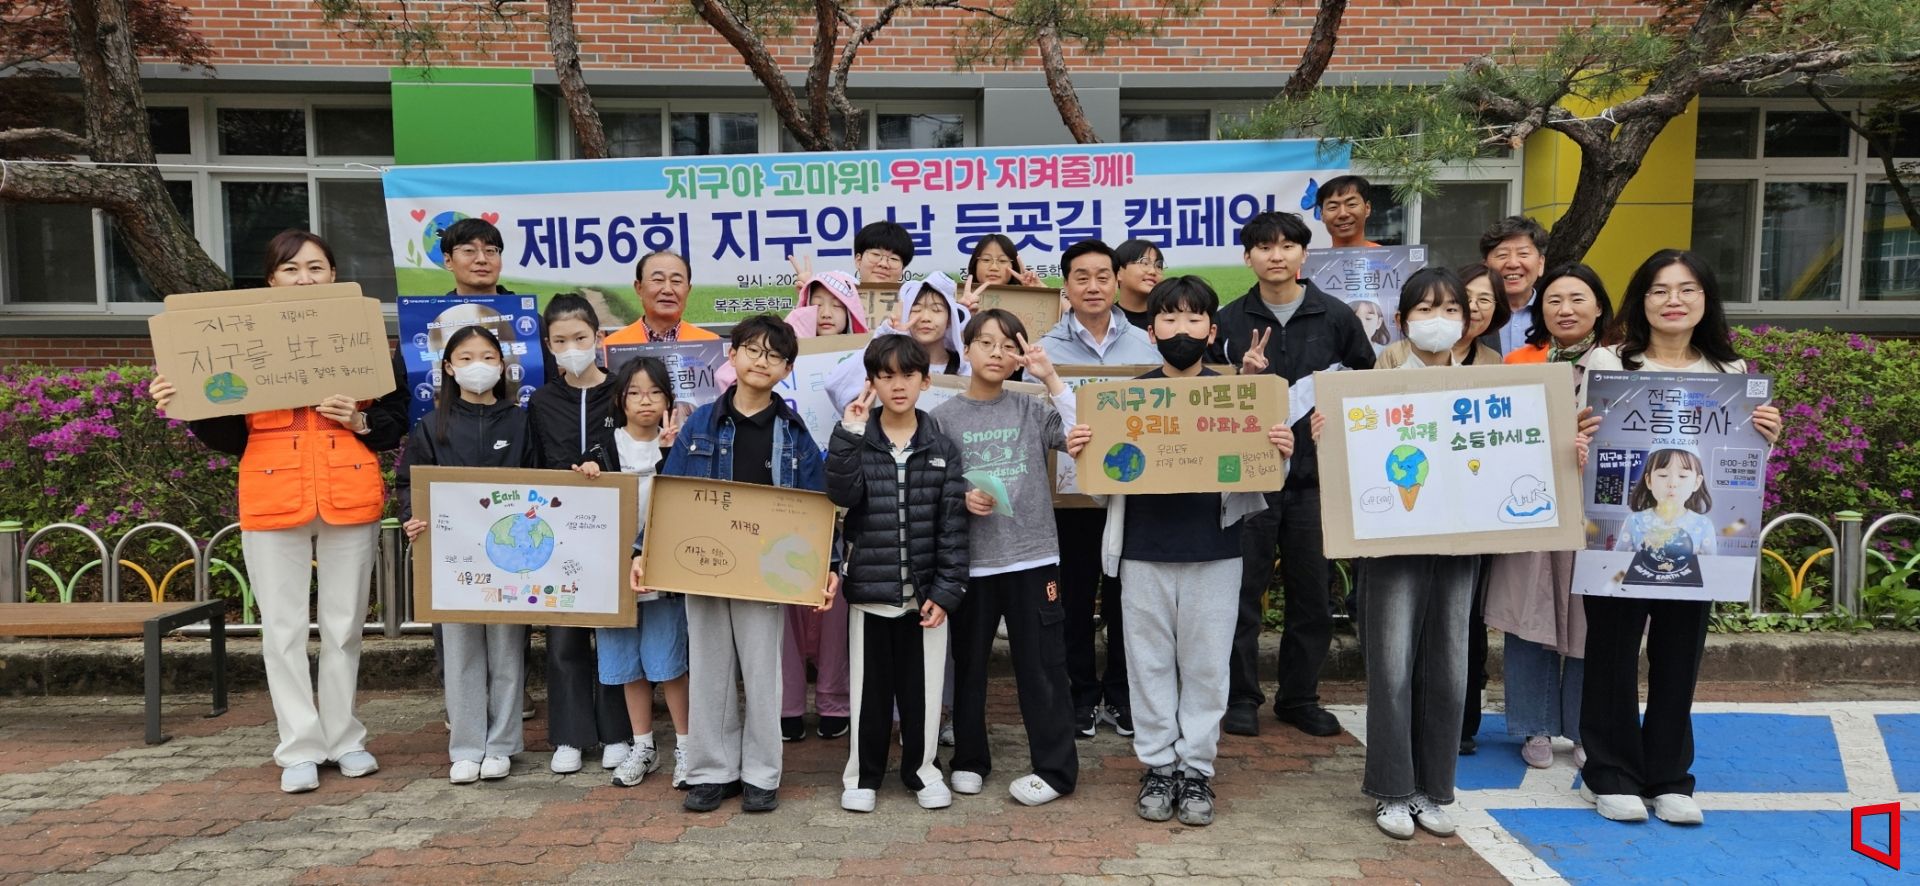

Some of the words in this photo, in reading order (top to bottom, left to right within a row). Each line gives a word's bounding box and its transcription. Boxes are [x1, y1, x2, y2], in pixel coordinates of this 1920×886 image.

[664, 164, 764, 199] 지구야
[774, 161, 879, 195] 고마워!
[890, 158, 987, 193] 우리가
[996, 154, 1133, 189] 지켜줄께!
[517, 212, 691, 268] 제56회
[711, 206, 862, 261] 지구의
[955, 200, 1102, 256] 등굣길
[737, 274, 762, 288] 일시
[1325, 272, 1400, 291] 소등행사
[194, 315, 256, 332] 지구를
[179, 339, 272, 374] 지구를
[287, 335, 322, 361] 보호
[256, 369, 310, 385] 에너지를
[313, 367, 336, 378] 절약
[1097, 386, 1176, 412] 지구가
[1189, 382, 1257, 410] 아프면
[1648, 388, 1682, 406] 전국
[1125, 415, 1180, 441] 우리도
[1196, 415, 1262, 433] 아파요
[1348, 404, 1379, 432] 오늘
[1385, 403, 1414, 427] 10분
[1621, 409, 1732, 435] 소등행사
[962, 427, 1020, 444] Snoopy
[1397, 421, 1438, 442] 지구를
[1450, 427, 1545, 451] 소등하세요.
[491, 490, 520, 505] Earth
[528, 489, 548, 506] Day
[694, 489, 733, 511] 지구를
[457, 571, 473, 586] 4월
